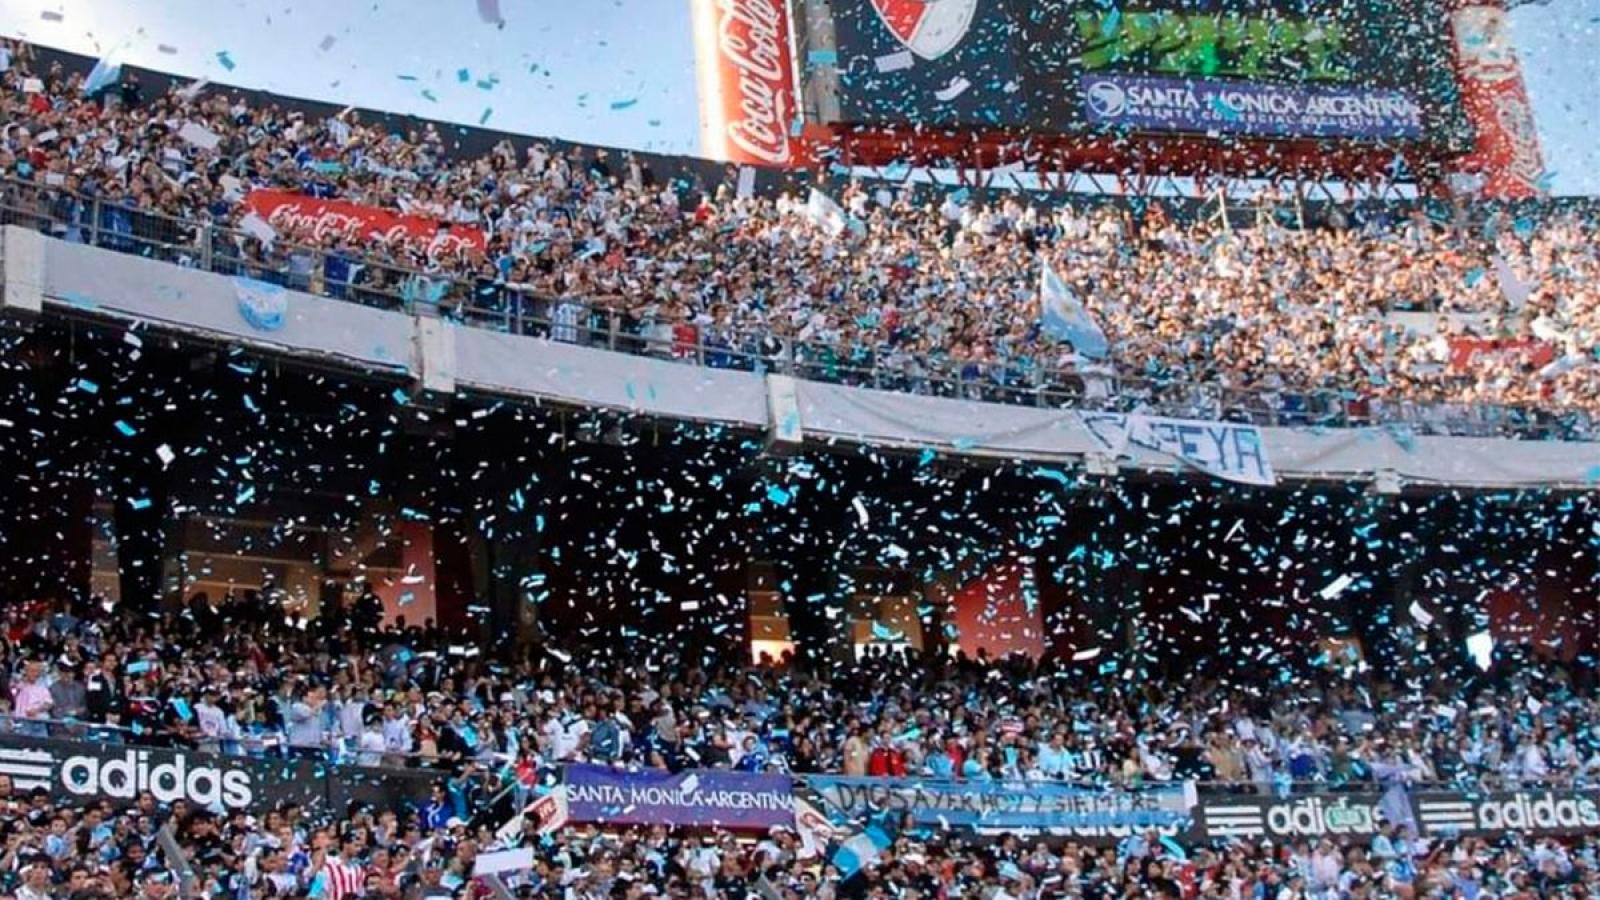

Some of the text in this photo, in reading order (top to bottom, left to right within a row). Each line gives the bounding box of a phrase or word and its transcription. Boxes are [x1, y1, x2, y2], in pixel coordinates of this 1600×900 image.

[1127, 86, 1200, 109] SANTA
[61, 750, 252, 808] adidas
[567, 784, 795, 812] SANTA MONICA ARGENTINA
[1480, 792, 1600, 829] adidas
